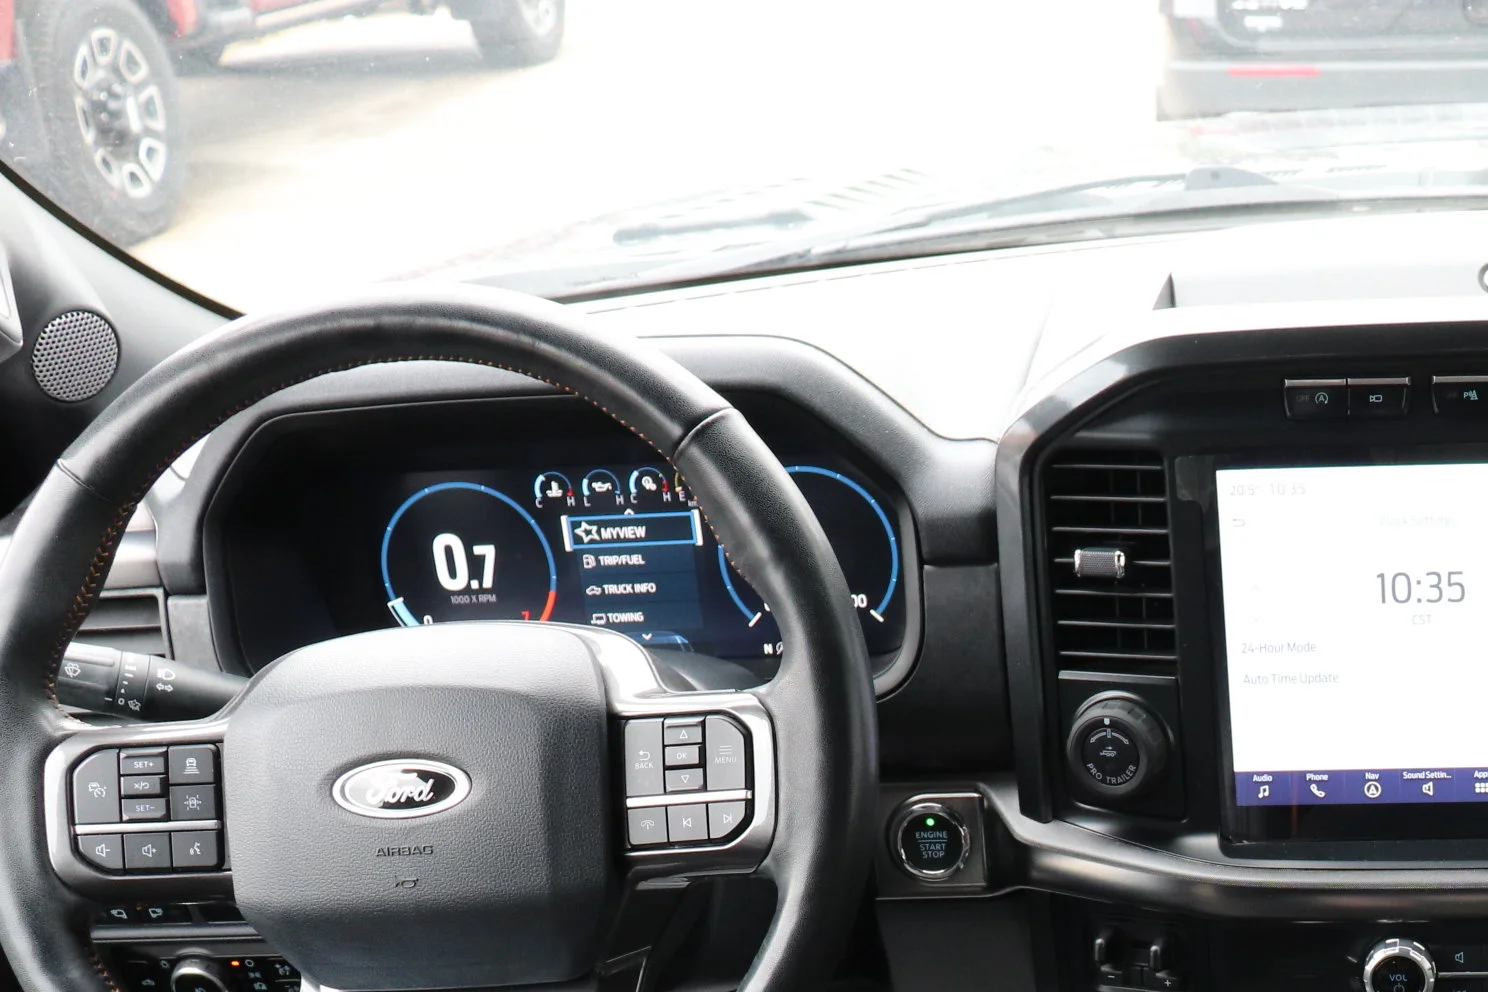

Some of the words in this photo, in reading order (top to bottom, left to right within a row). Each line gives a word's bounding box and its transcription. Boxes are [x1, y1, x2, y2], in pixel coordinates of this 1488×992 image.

[615, 495, 624, 505] H
[630, 493, 638, 504] C
[663, 492, 671, 502] H
[678, 491, 686, 501] E
[535, 498, 543, 508] C
[567, 496, 576, 507] H
[584, 497, 591, 507] L
[601, 526, 646, 540] MYVIEW
[432, 532, 496, 592] 0.7
[598, 554, 645, 566] TRIP/FUEL
[602, 583, 633, 595] TRUCK
[634, 582, 657, 593] INFO
[1376, 571, 1466, 605] 10:35
[450, 595, 470, 604] 1000
[478, 594, 496, 603] RPM
[607, 612, 644, 623] TOWING
[1411, 614, 1432, 625] CST
[1241, 642, 1284, 654] 24-Hour
[1286, 640, 1317, 653] Mode
[1242, 673, 1269, 686] Auto
[1270, 672, 1298, 685] Time
[1299, 671, 1340, 687] Update
[676, 752, 687, 760] OK
[714, 756, 737, 764] MENU
[634, 762, 654, 770] BACK
[1086, 762, 1103, 780] PRO
[1106, 764, 1137, 785] TRAILER
[1253, 773, 1273, 782] Audio
[1306, 772, 1328, 781] Phone
[1365, 772, 1379, 780] Nav
[1403, 771, 1425, 780] Sound
[915, 831, 948, 839] ENGINE
[376, 845, 434, 857] AIRBAG
[920, 843, 946, 851] START
[922, 850, 945, 859] STOP
[1389, 974, 1408, 982] VOL
